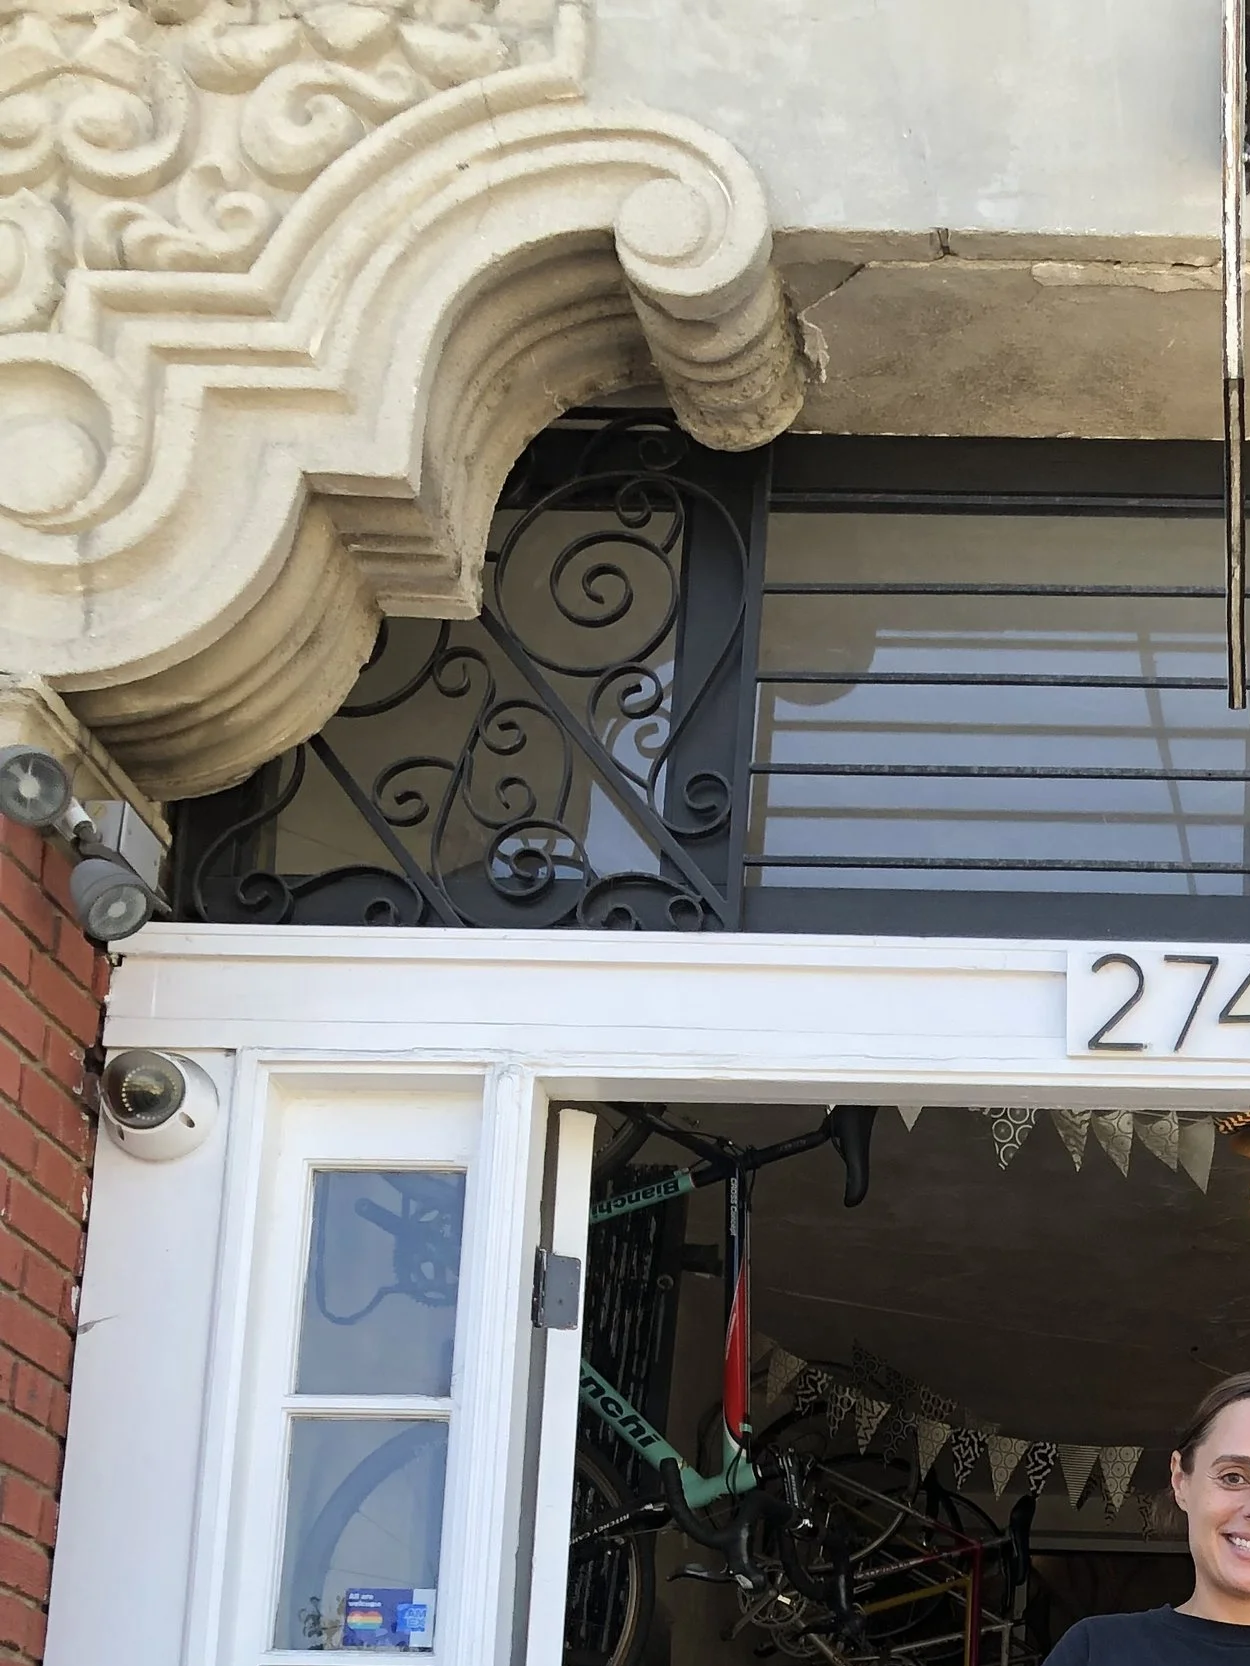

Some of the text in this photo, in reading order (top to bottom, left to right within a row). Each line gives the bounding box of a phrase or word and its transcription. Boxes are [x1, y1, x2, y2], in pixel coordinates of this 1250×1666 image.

[592, 1178, 680, 1219] Bianchi
[580, 1363, 661, 1448] nchi
[593, 1513, 630, 1535] RITCHEY
